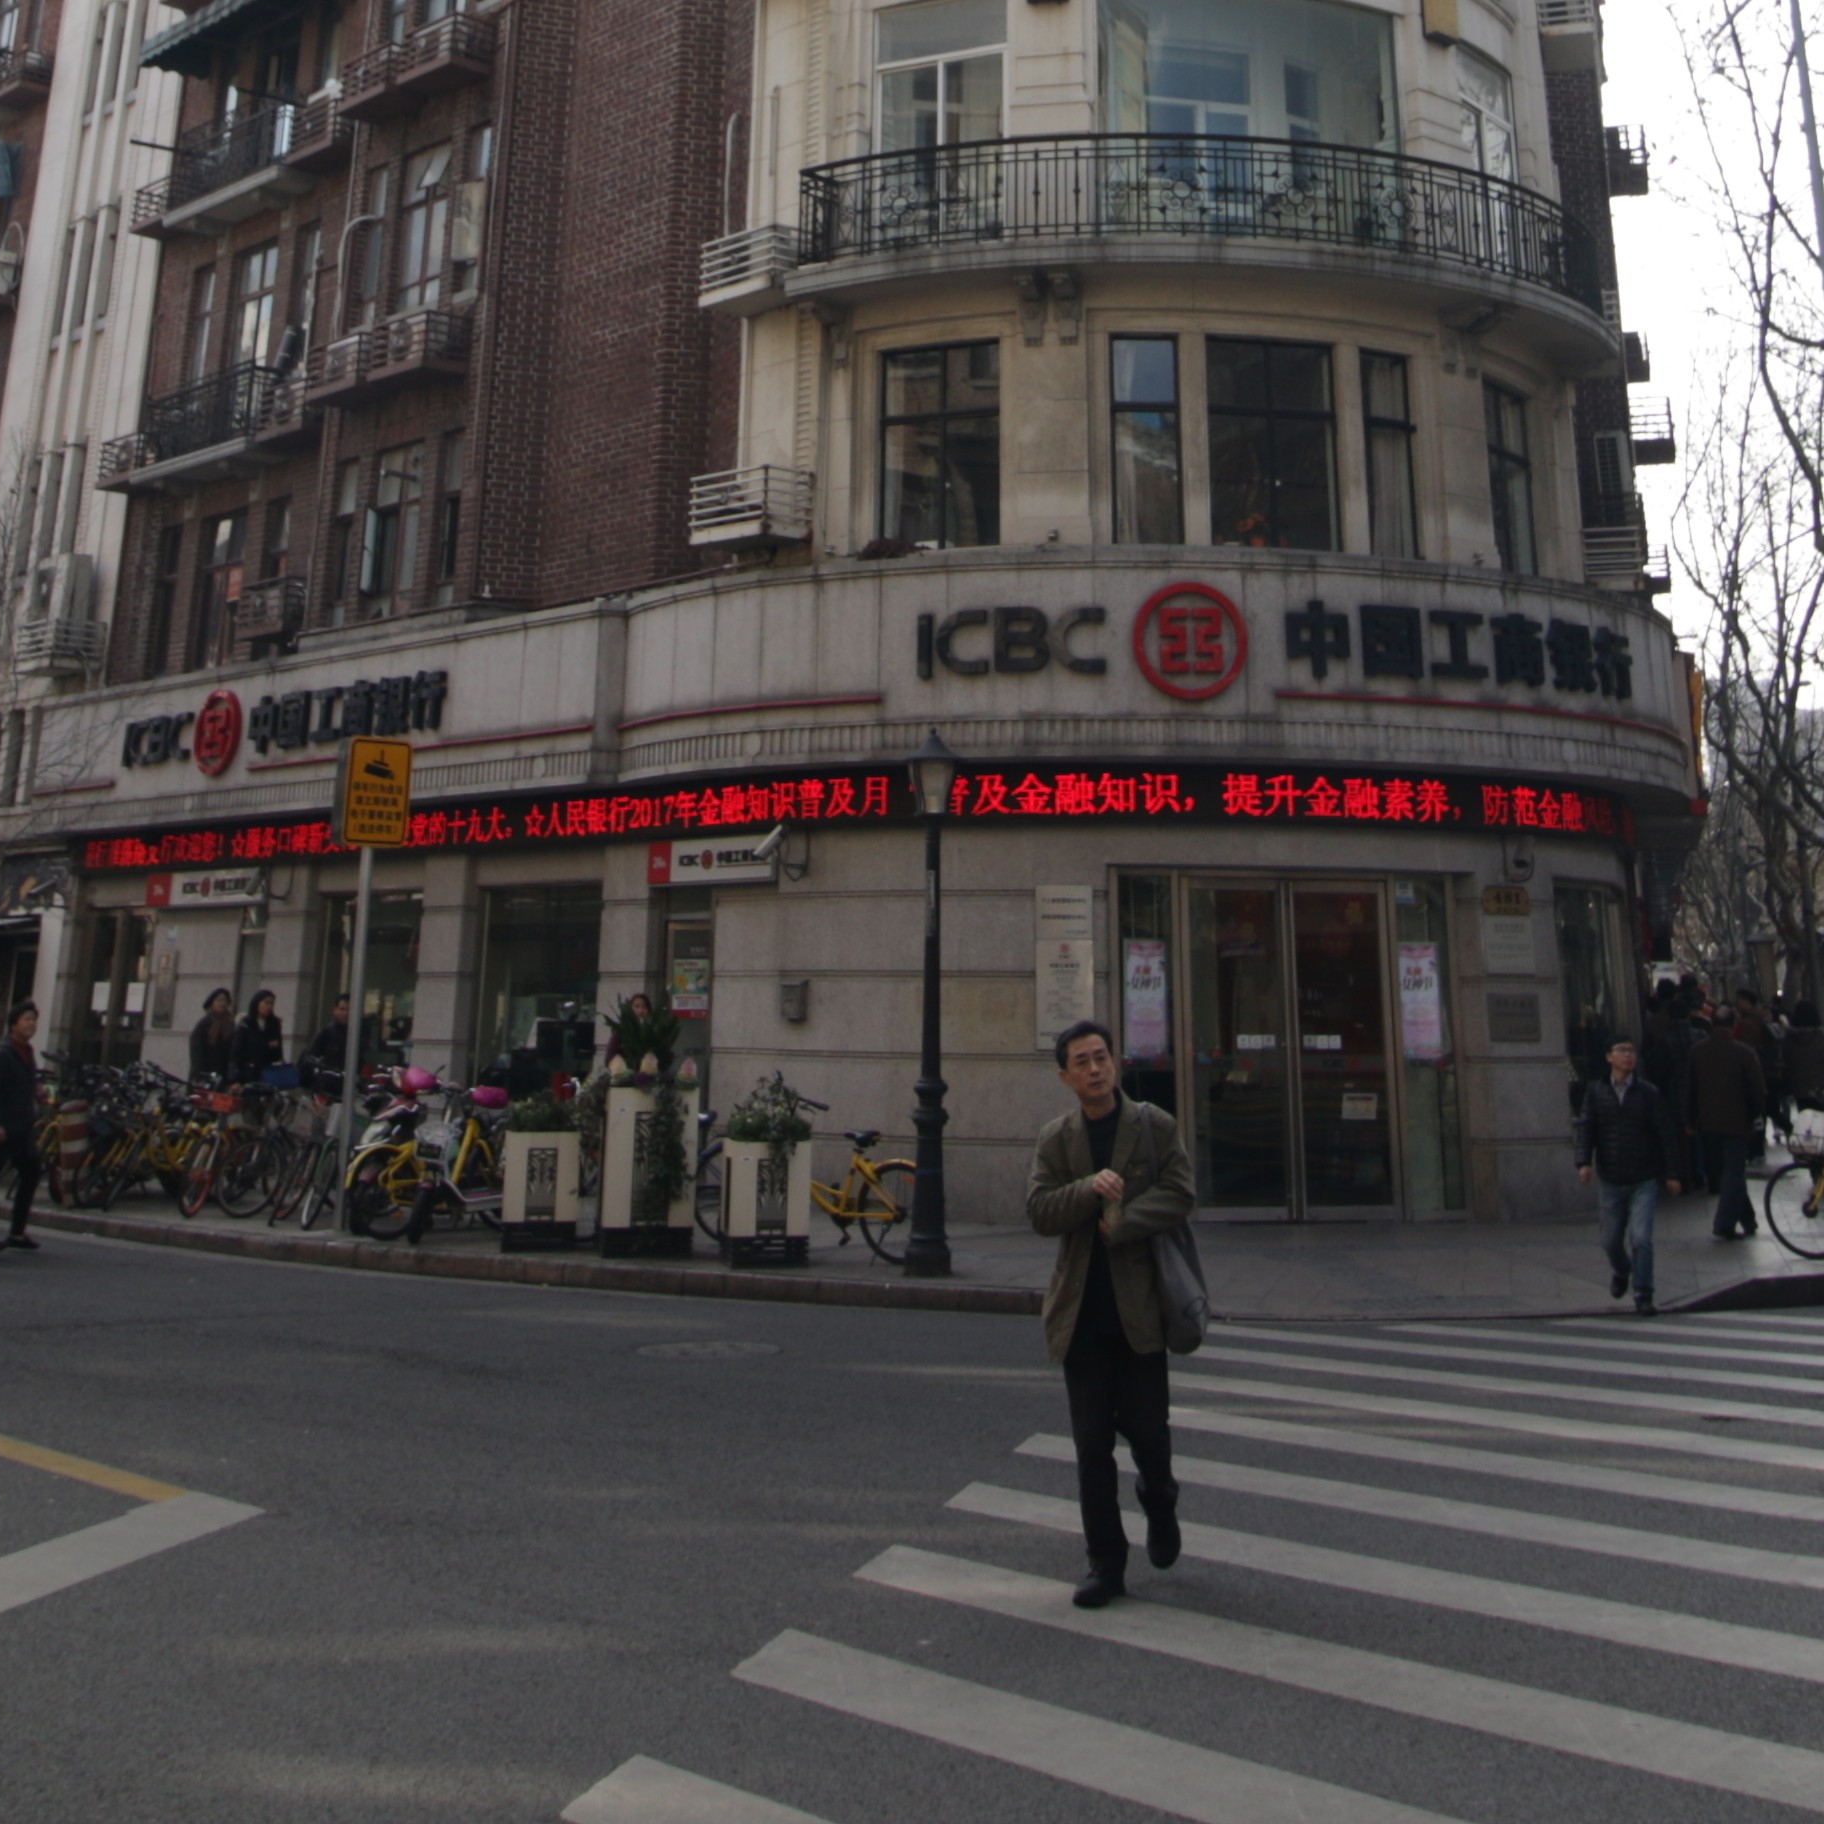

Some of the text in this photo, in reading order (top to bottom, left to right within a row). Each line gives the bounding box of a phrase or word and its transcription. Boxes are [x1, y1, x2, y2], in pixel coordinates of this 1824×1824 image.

[917, 599, 1633, 700] ICBC 中国工商银行
[122, 670, 448, 767] ICBC 中国工商银行
